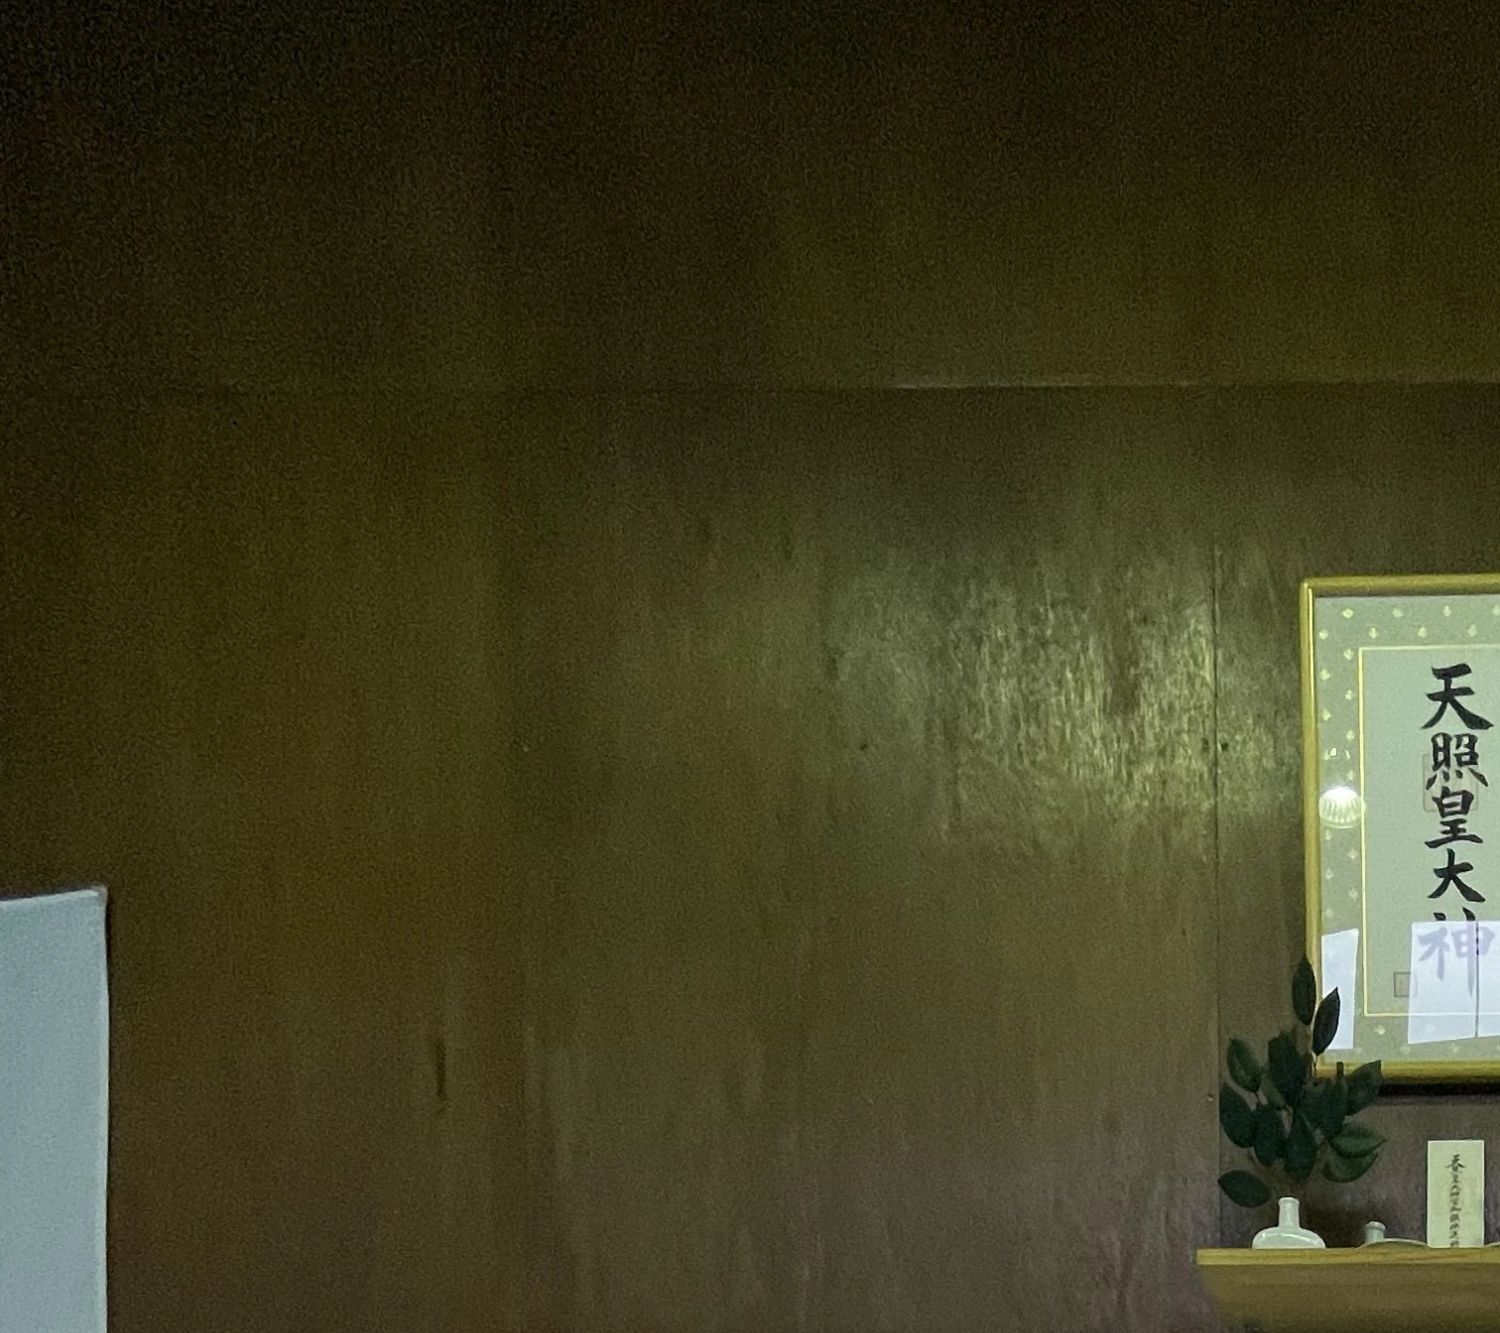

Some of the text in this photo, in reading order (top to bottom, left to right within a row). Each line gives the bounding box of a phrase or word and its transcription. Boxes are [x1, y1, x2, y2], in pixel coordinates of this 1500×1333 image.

[1417, 663, 1496, 998] 天照皇大神
